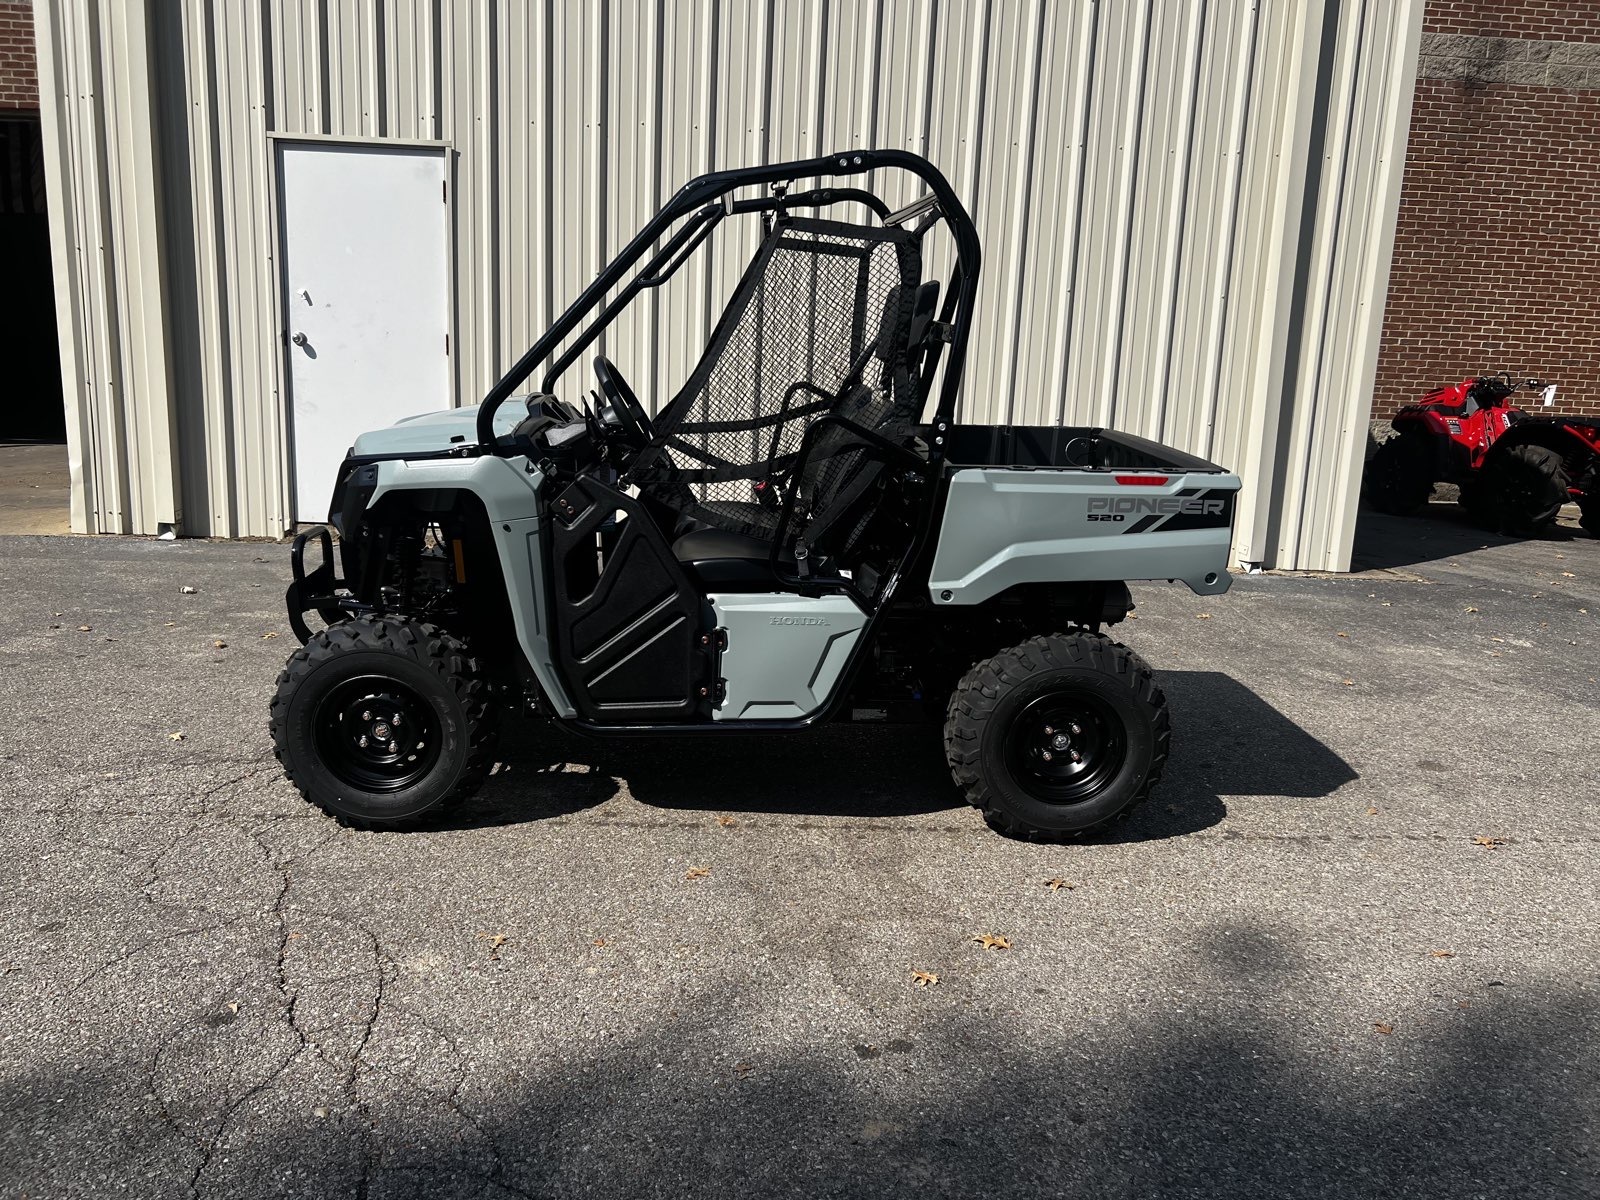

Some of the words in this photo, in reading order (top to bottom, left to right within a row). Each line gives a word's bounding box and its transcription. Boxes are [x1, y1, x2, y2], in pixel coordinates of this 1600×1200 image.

[1087, 497, 1225, 515] PIONEER
[1087, 514, 1125, 522] 520
[769, 615, 831, 627] HONDA
